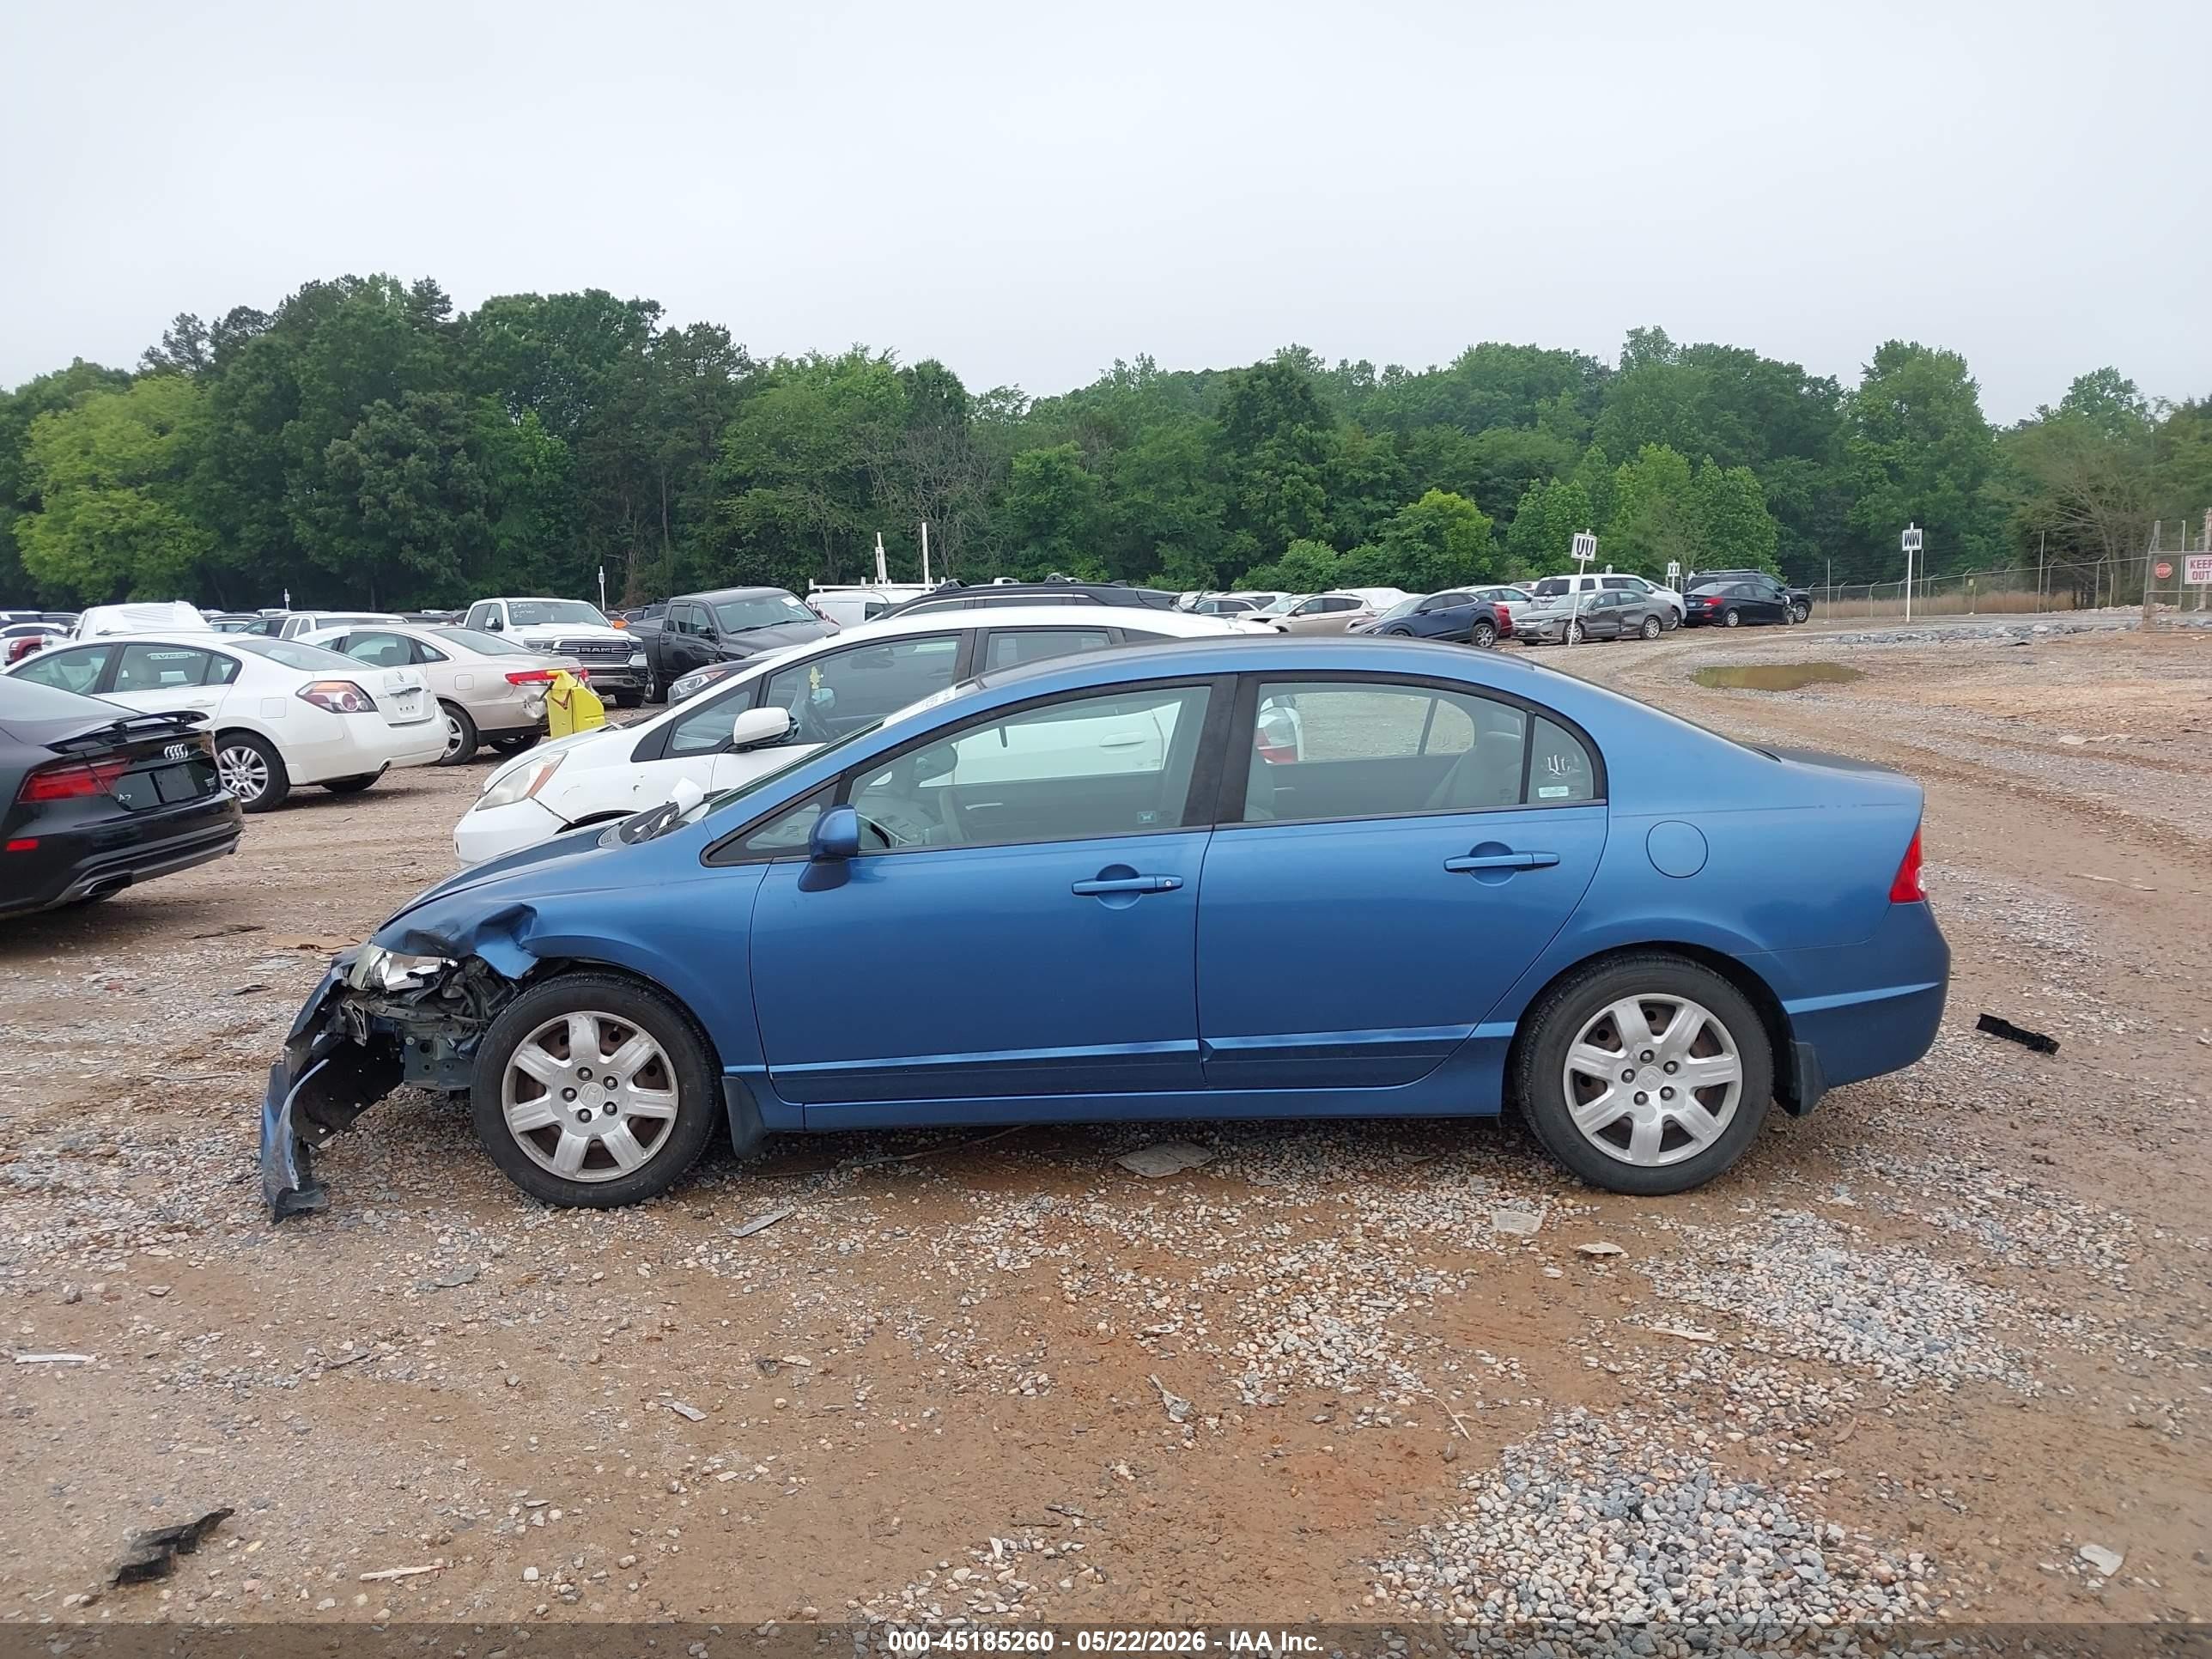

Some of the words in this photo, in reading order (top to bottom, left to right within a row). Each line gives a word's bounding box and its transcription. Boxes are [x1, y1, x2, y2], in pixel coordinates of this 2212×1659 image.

[1577, 538, 1594, 556] UU
[1669, 564, 1680, 577] XX
[2192, 570, 2211, 580] OUT
[118, 793, 131, 803] A7
